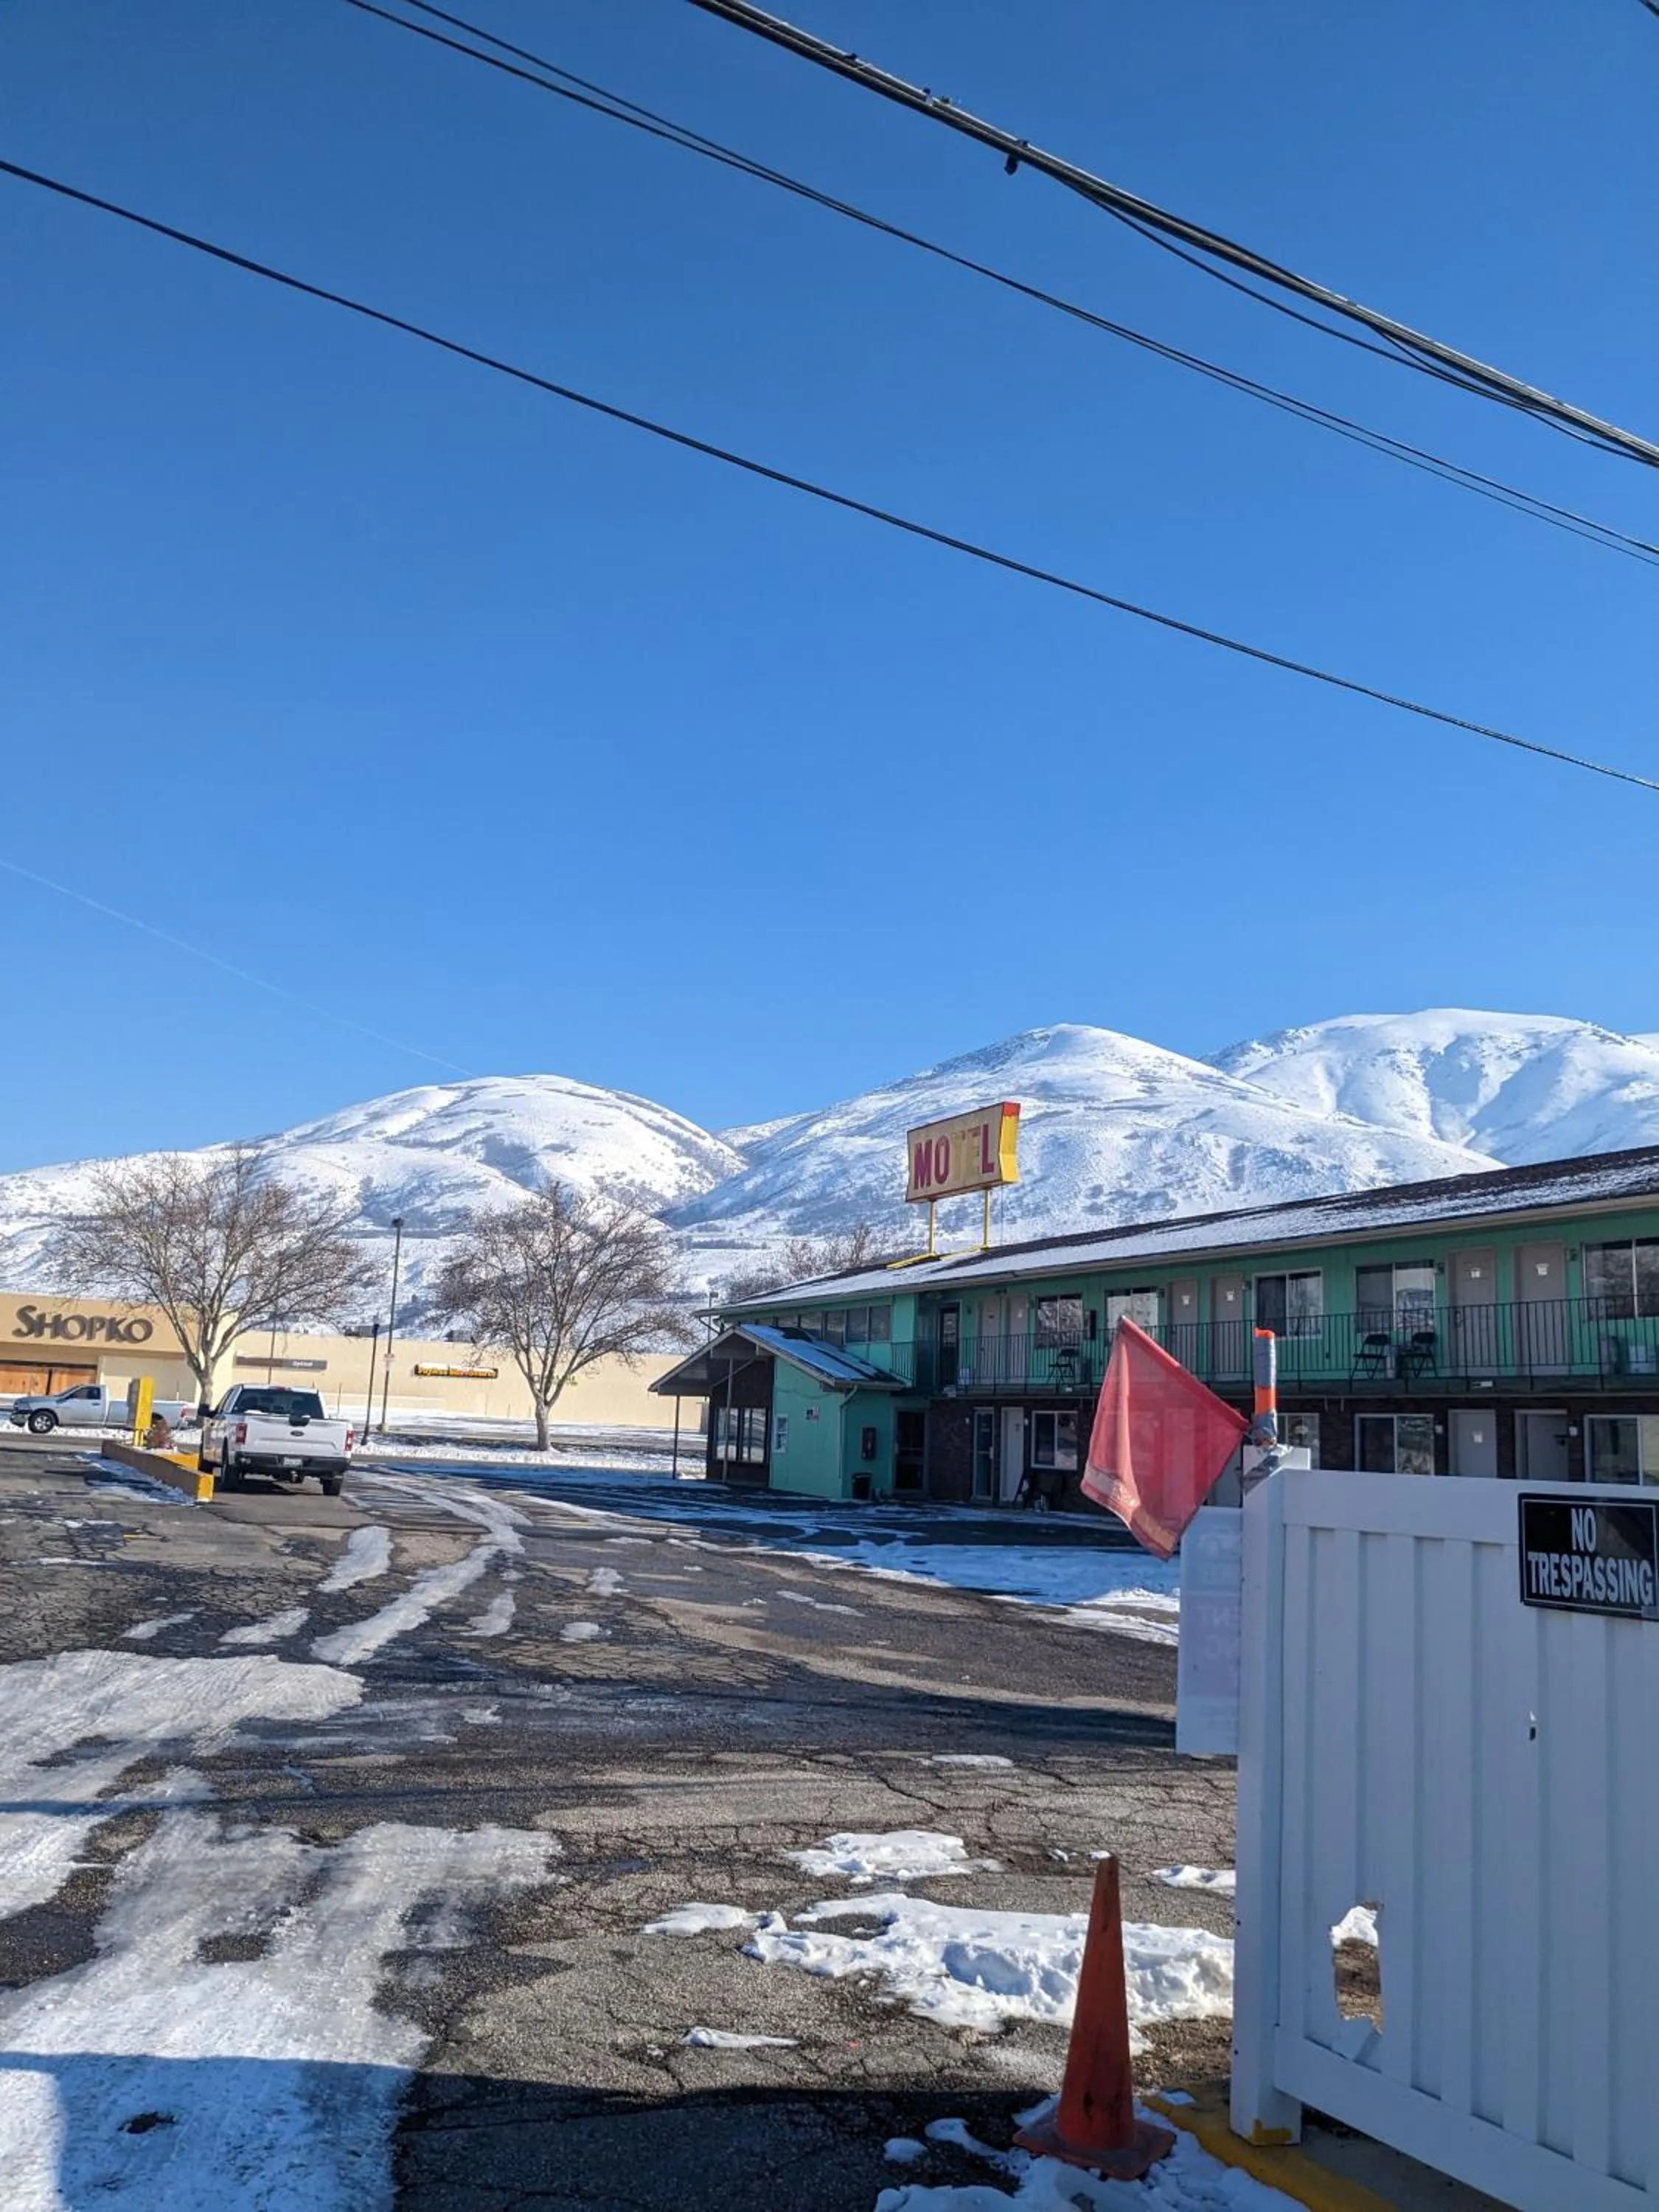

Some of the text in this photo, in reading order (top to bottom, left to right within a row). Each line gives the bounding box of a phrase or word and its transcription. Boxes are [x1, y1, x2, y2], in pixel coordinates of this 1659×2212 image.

[12, 1305, 153, 1343] SHOPKO
[1571, 1508, 1597, 1552] NO
[1528, 1551, 1653, 1605] TRESPASSING
